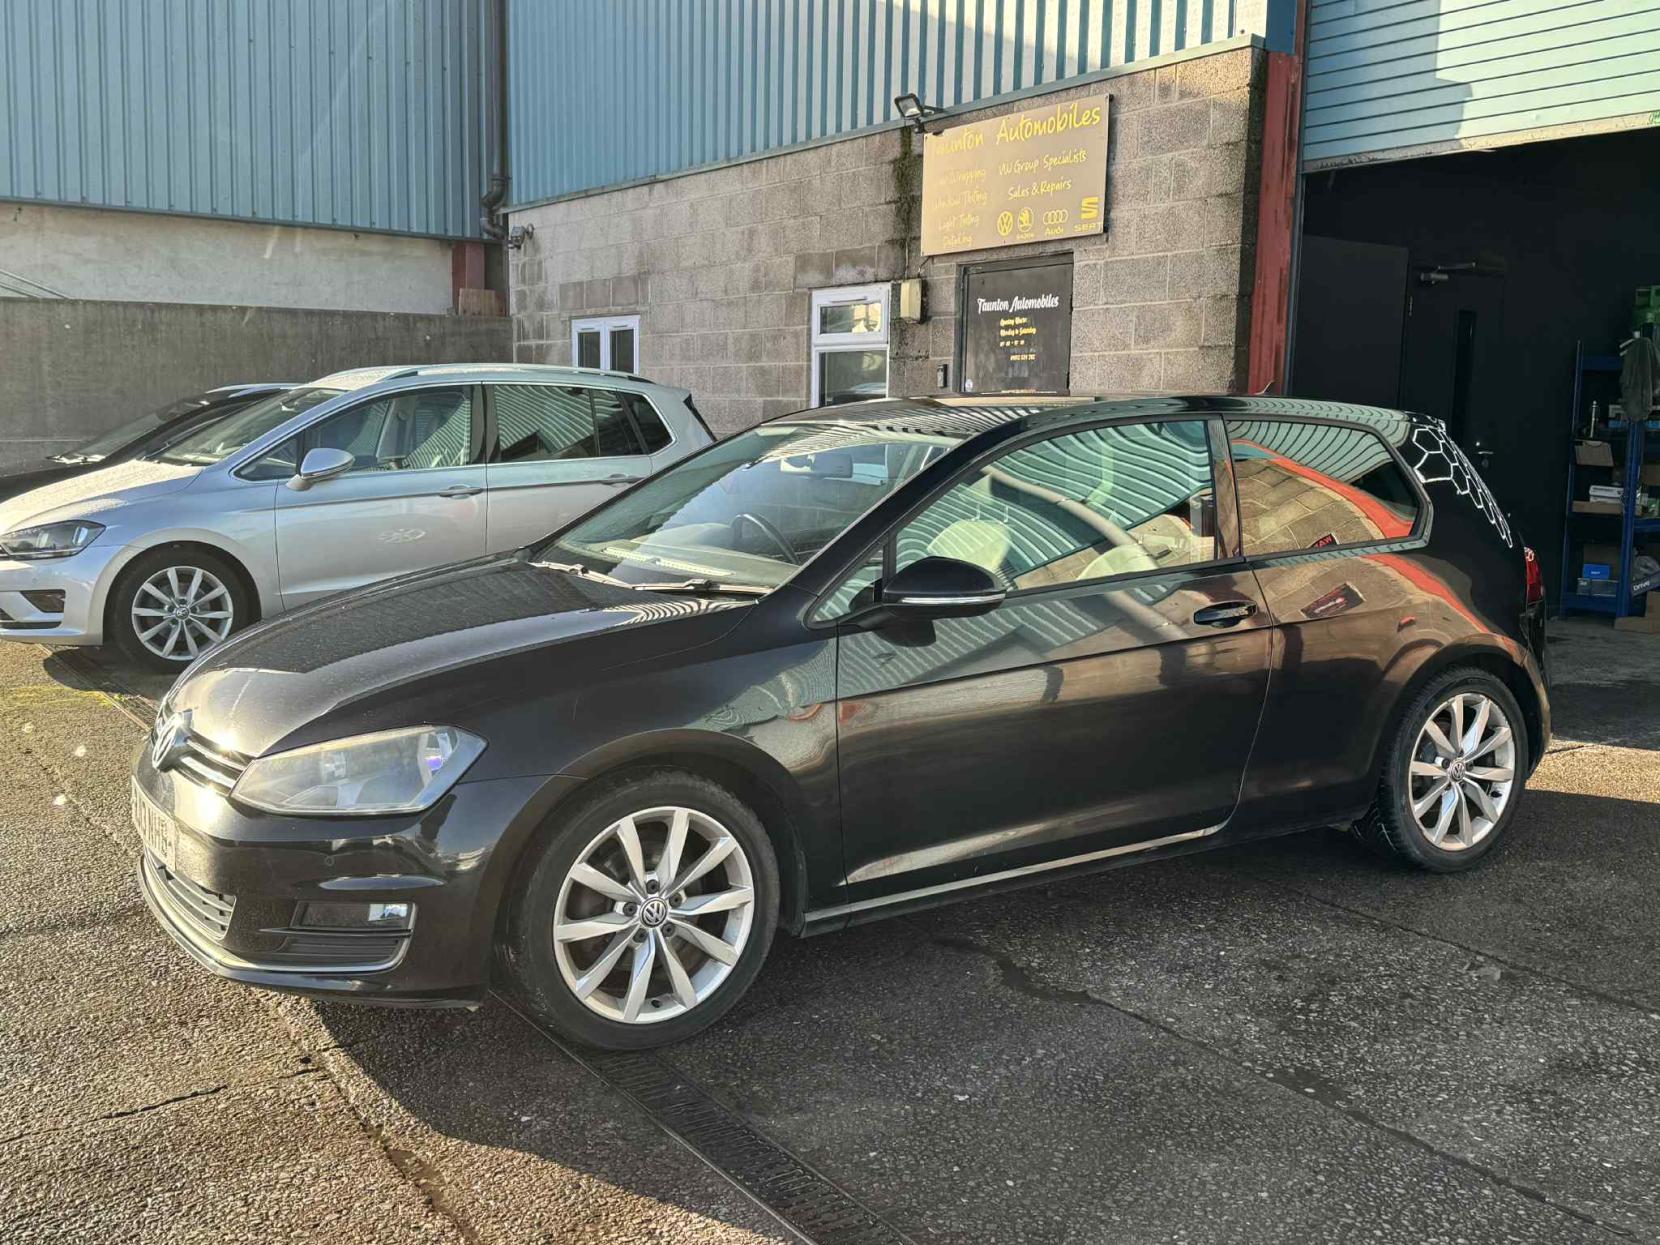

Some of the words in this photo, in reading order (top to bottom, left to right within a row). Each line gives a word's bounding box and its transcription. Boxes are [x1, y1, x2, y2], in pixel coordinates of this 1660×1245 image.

[932, 131, 984, 155] aunton
[996, 102, 1101, 145] Automobiles
[1013, 159, 1040, 174] Group
[1043, 149, 1087, 171] Specialists
[1008, 185, 1030, 201] Sales
[1041, 176, 1073, 197] Repairs
[1044, 226, 1064, 236] Audi
[1074, 221, 1102, 233] SEAT
[977, 297, 1009, 315] Taunton
[1009, 293, 1060, 313] Automobiles
